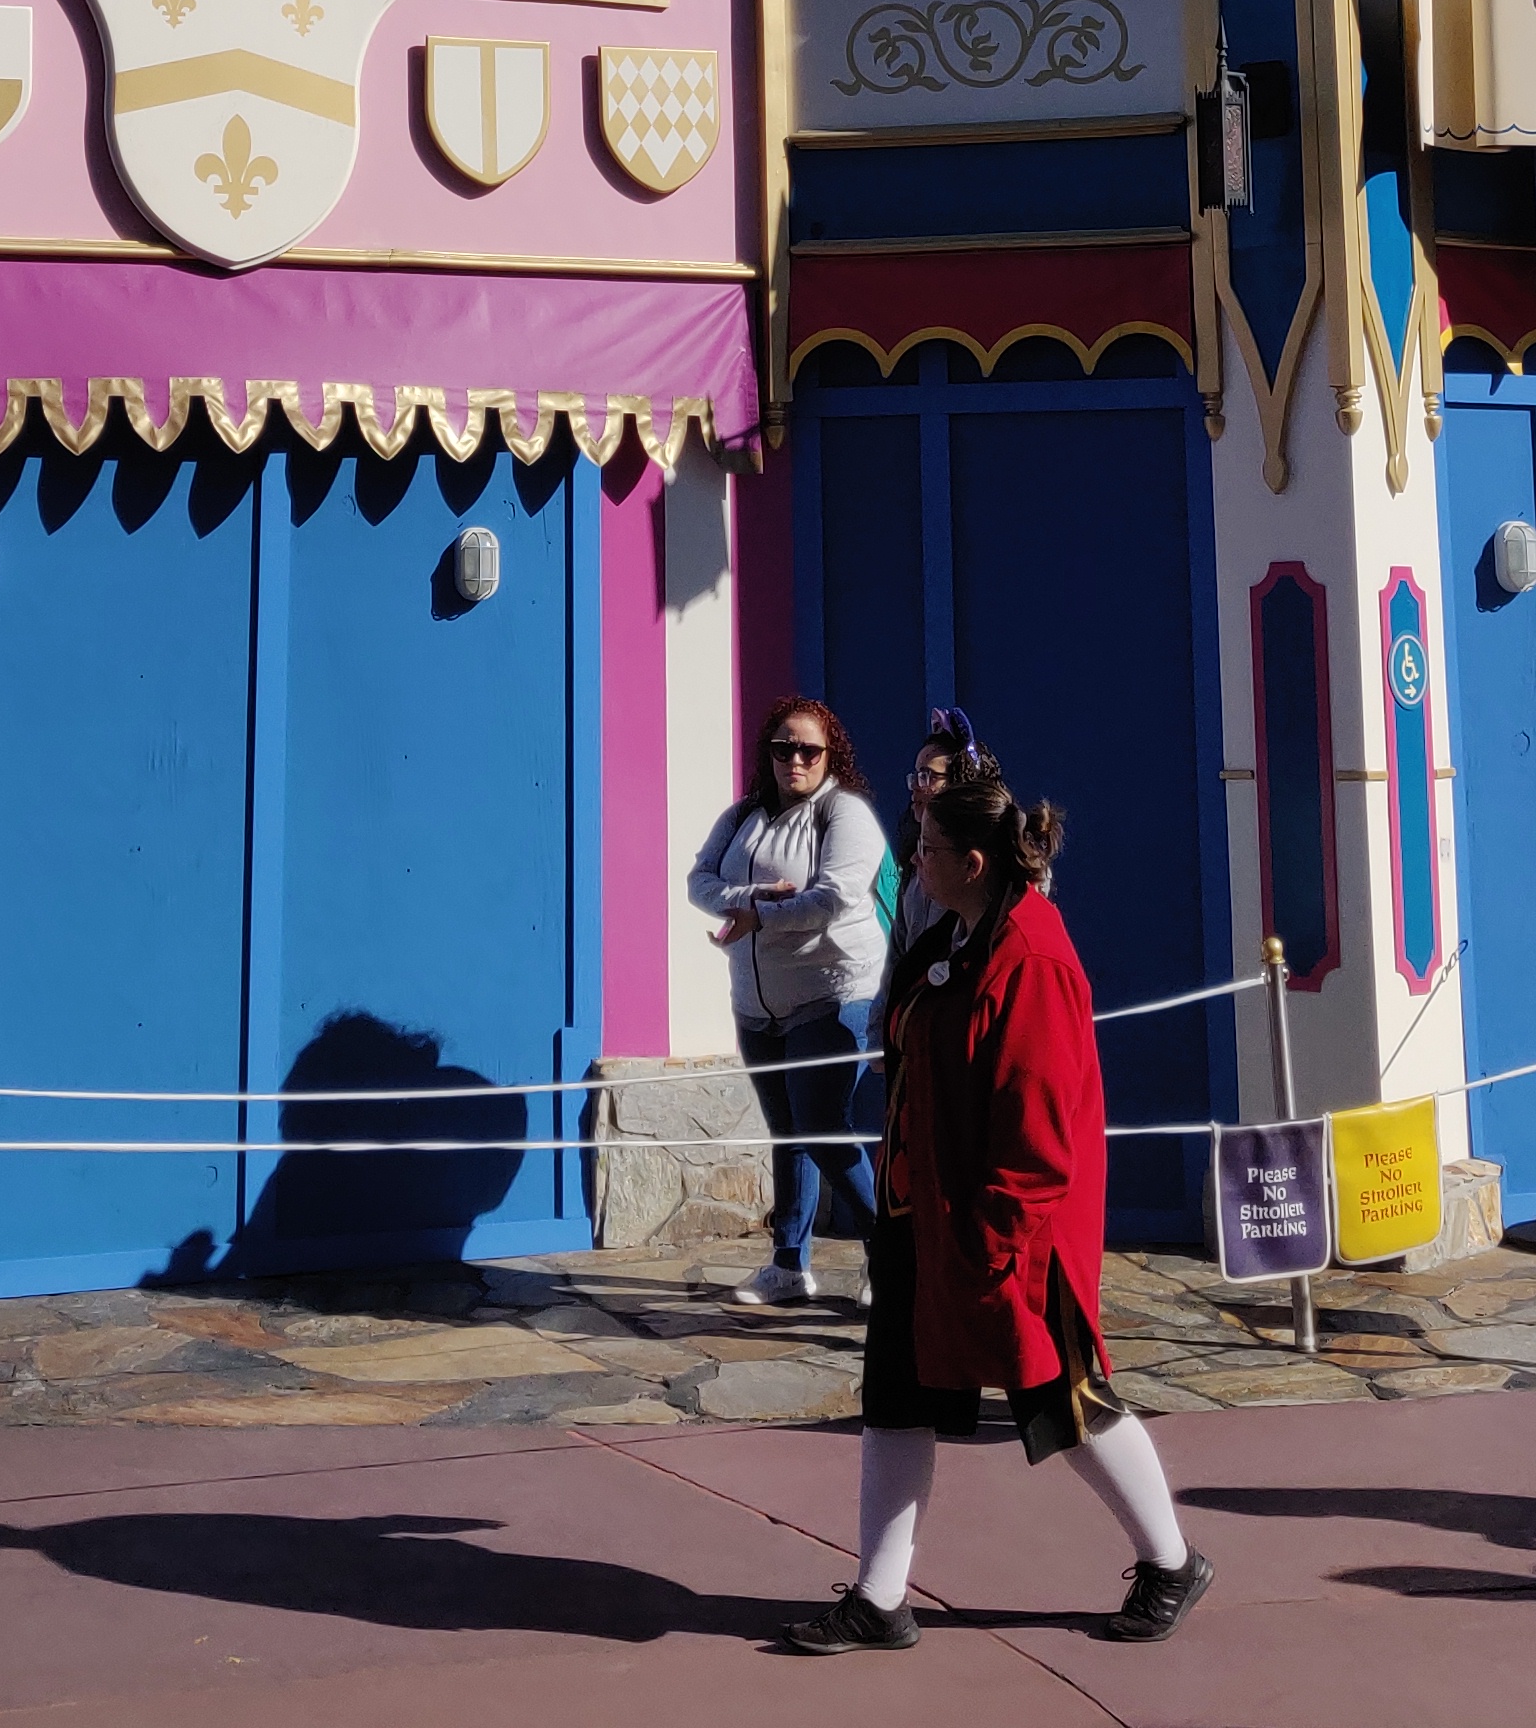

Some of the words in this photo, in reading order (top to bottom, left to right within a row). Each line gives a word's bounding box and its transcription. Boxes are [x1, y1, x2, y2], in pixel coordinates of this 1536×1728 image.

[1364, 1146, 1413, 1168] Please
[1247, 1166, 1297, 1184] Please
[1379, 1168, 1403, 1184] No
[1263, 1185, 1287, 1202] No
[1360, 1181, 1423, 1206] Stroller
[1240, 1202, 1306, 1221] Stroller
[1361, 1198, 1423, 1224] Parking
[1240, 1219, 1307, 1240] Parking
